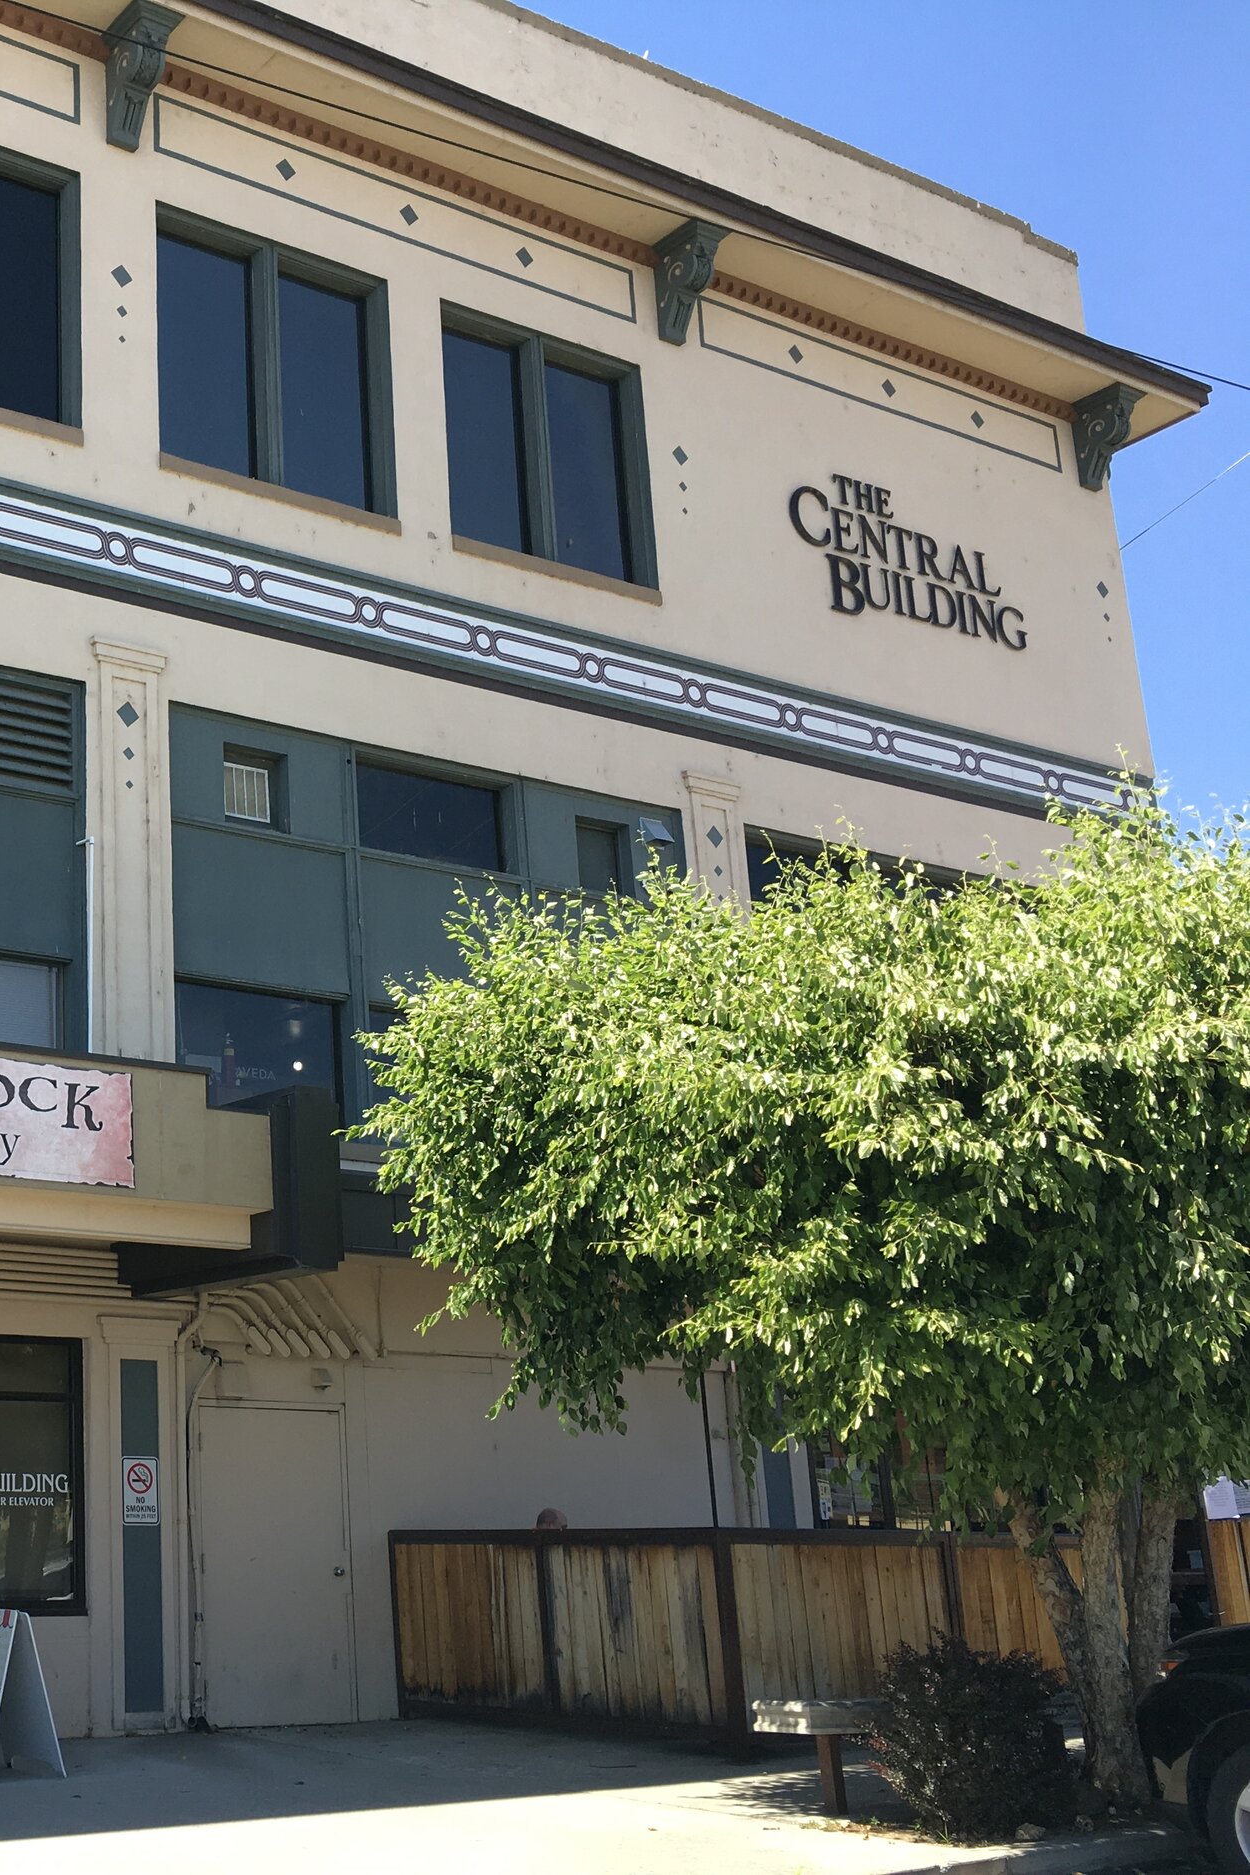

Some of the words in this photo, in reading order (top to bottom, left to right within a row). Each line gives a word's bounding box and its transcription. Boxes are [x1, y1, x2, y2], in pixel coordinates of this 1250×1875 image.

[832, 473, 894, 519] THE
[788, 485, 1002, 598] CENTRAL
[824, 552, 1028, 651] BUILDING
[8, 1496, 55, 1507] ELEVATOR
[126, 1505, 156, 1513] SMOKING
[136, 1496, 145, 1504] NO
